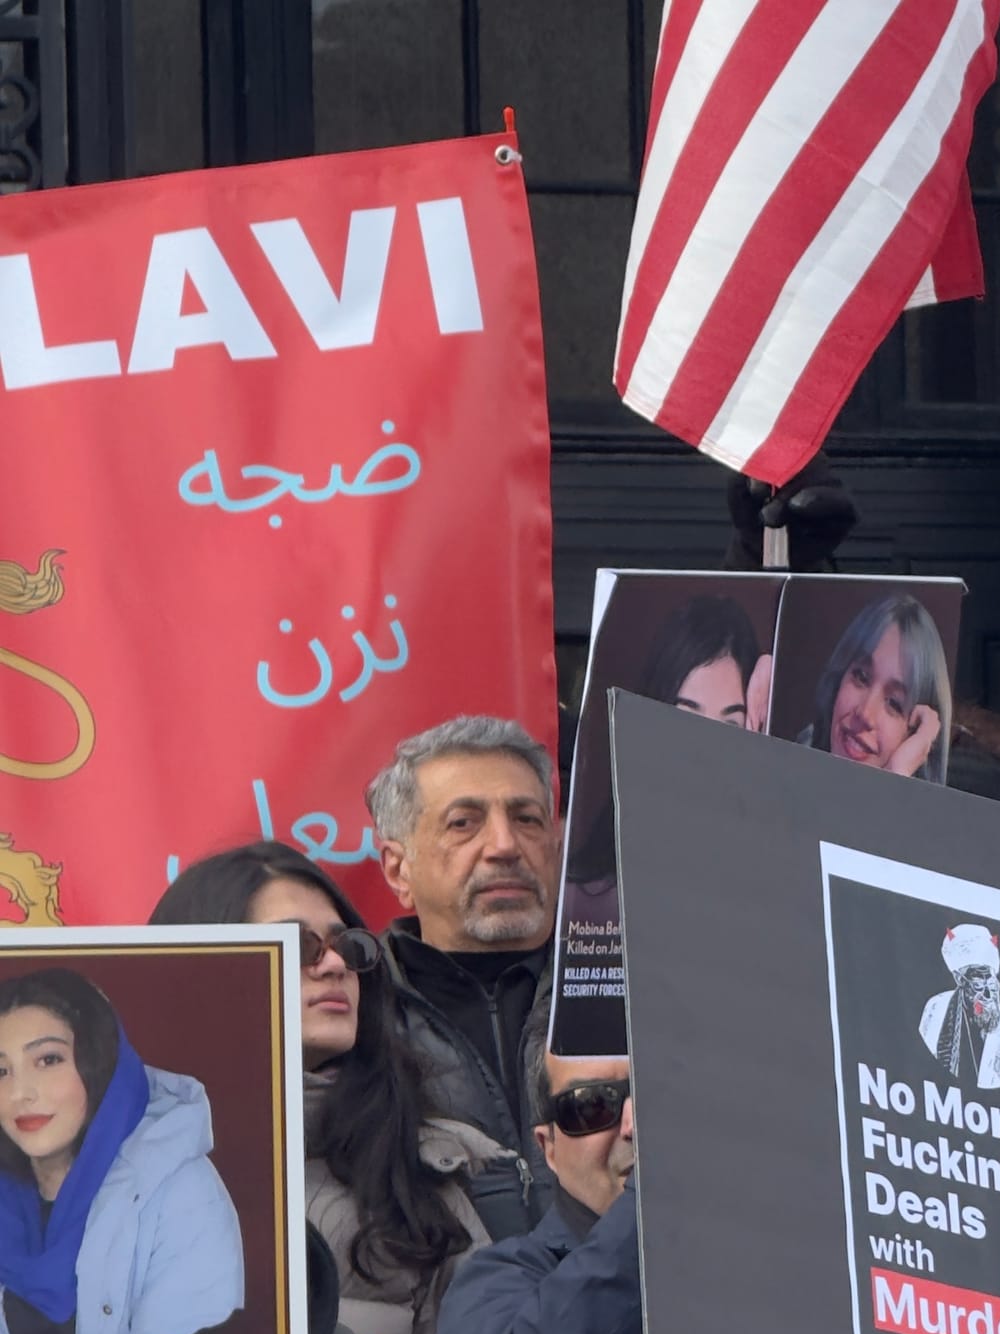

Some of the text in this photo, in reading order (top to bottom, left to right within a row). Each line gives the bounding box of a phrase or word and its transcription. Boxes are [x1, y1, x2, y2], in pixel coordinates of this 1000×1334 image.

[0, 197, 484, 390] LAVI
[178, 420, 422, 529] ضجه
[256, 594, 409, 708] نزن
[567, 939, 595, 955] Killed
[596, 945, 607, 955] on
[568, 920, 604, 935] Mobina
[563, 984, 598, 997] SECURITY
[564, 967, 589, 980] KILLED
[590, 967, 601, 980] AS
[601, 967, 607, 980] A
[858, 1062, 915, 1117] No
[866, 1171, 986, 1241] Deals
[869, 1233, 935, 1273] with
